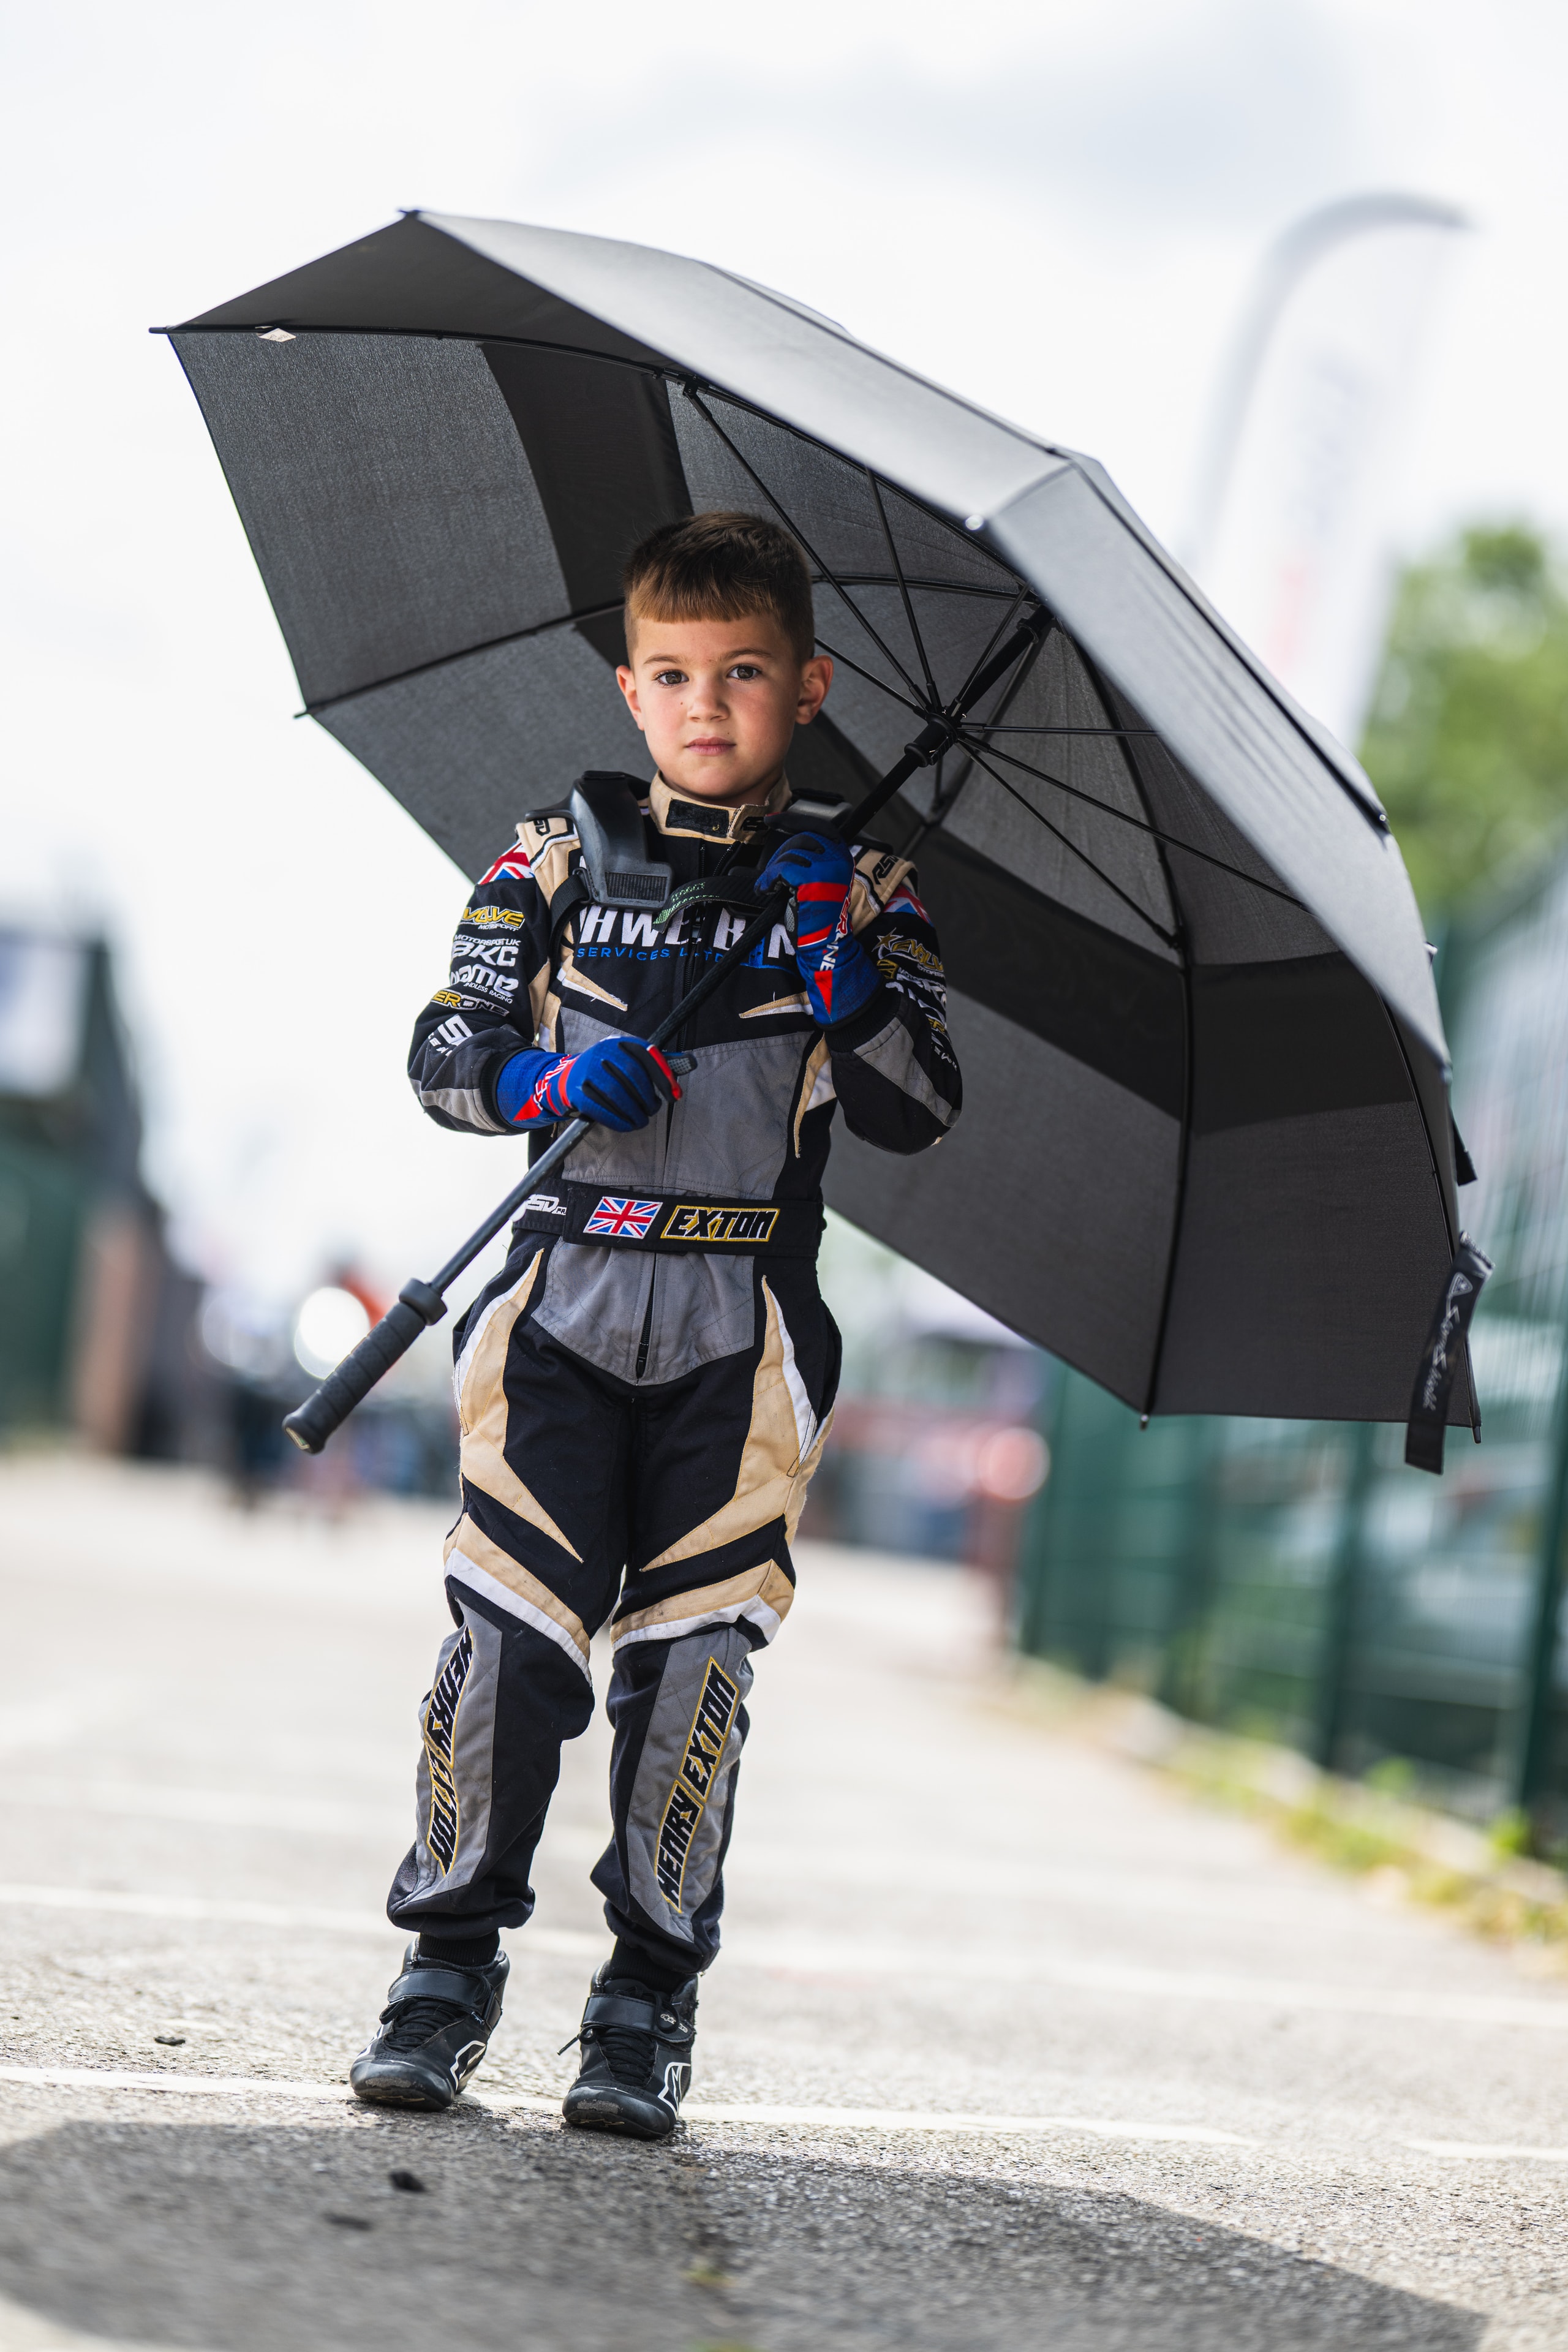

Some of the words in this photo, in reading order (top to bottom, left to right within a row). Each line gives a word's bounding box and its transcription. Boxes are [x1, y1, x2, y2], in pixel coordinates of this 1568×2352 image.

[461, 905, 526, 929] VOLVE
[450, 940, 519, 968] BKC
[505, 938, 522, 948] UK
[577, 946, 670, 961] SERVICES
[891, 938, 944, 972] EVOLV
[488, 990, 513, 1005] RACING
[665, 1206, 776, 1240] EXTON
[656, 1781, 703, 1912] HENRY
[680, 1657, 739, 1802] EXTON
